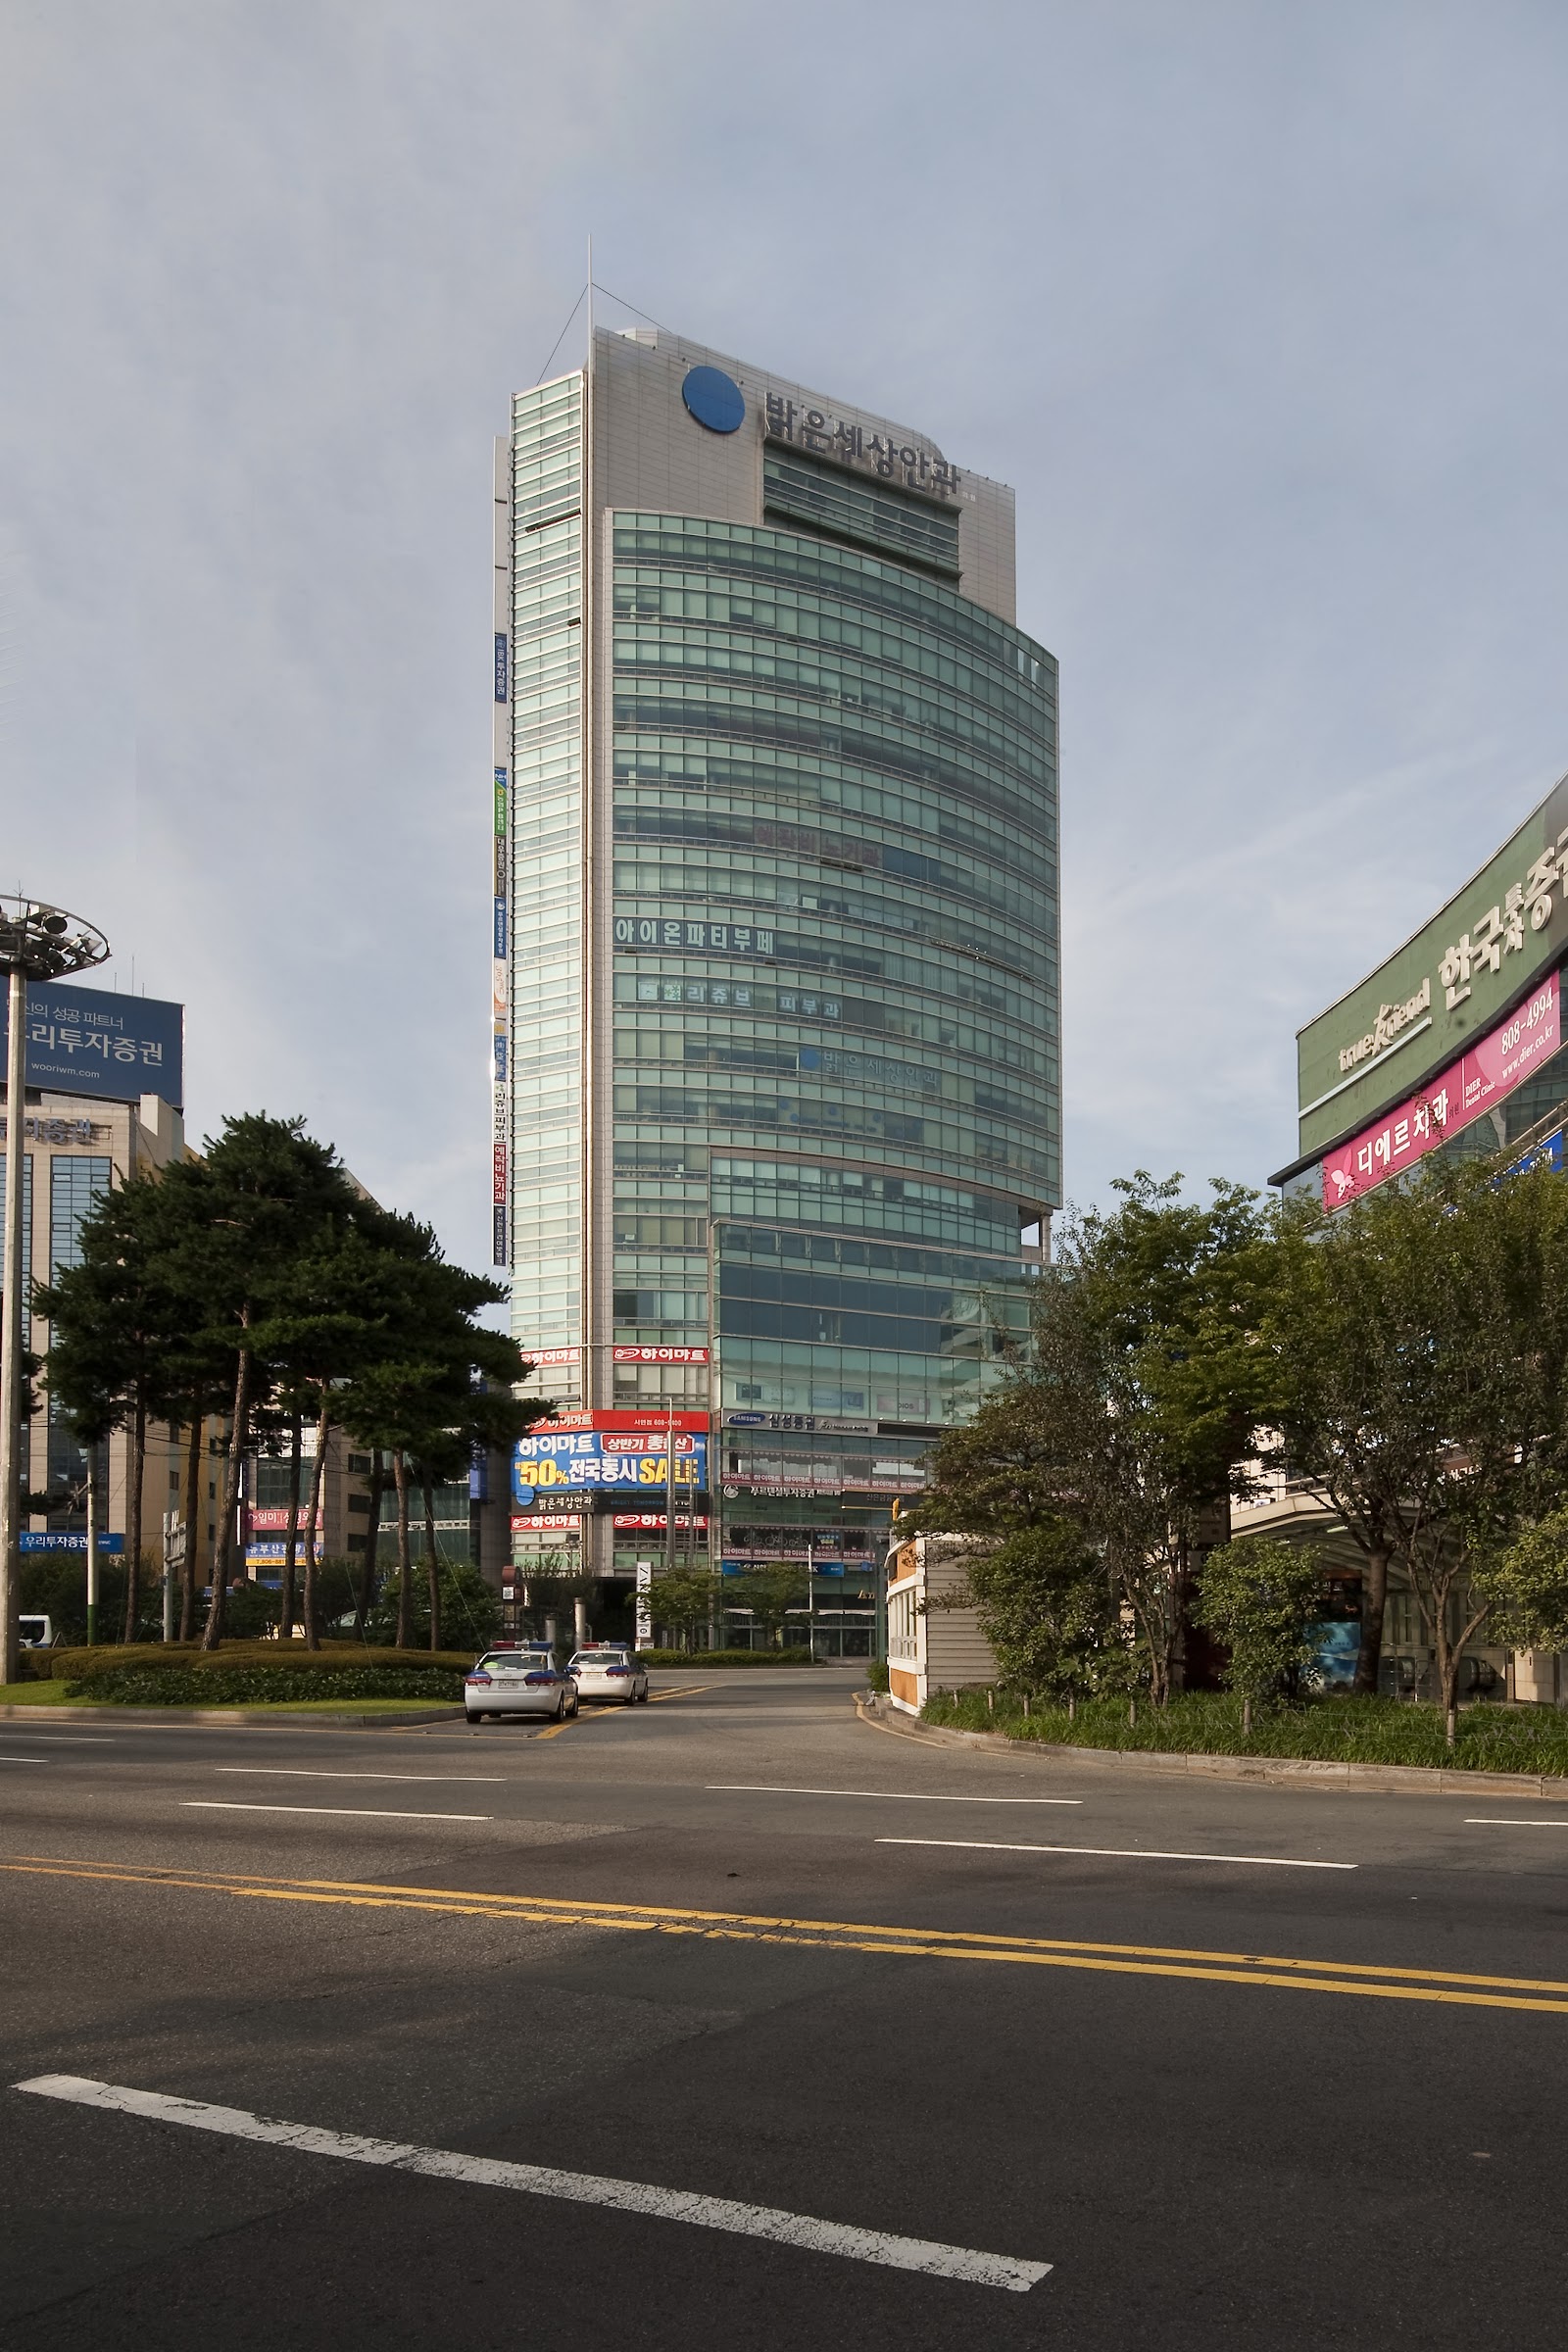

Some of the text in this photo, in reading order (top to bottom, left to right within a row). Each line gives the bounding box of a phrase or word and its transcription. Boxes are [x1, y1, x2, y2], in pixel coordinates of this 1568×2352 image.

[766, 392, 961, 495] 밝은세상안과
[7, 999, 123, 1030] 신의 성공 파트너
[780, 995, 840, 1019] 피부과
[1501, 987, 1553, 1055] 808-4994
[1501, 1024, 1554, 1079] www.dier.co.kr
[31, 1061, 100, 1078] wooriwm.com
[1465, 1077, 1481, 1097] DIER
[641, 1348, 706, 1361] 하이마트
[733, 1414, 761, 1423] SAMSUNG
[518, 1434, 594, 1456] 하이마트
[607, 1438, 645, 1450] 상반기
[520, 1458, 569, 1487] 50%
[639, 1457, 700, 1484] SALE
[538, 1495, 593, 1511] 밝은세상안과
[531, 1514, 580, 1527] 하이마트
[25, 1536, 88, 1547] 우리투자증권
